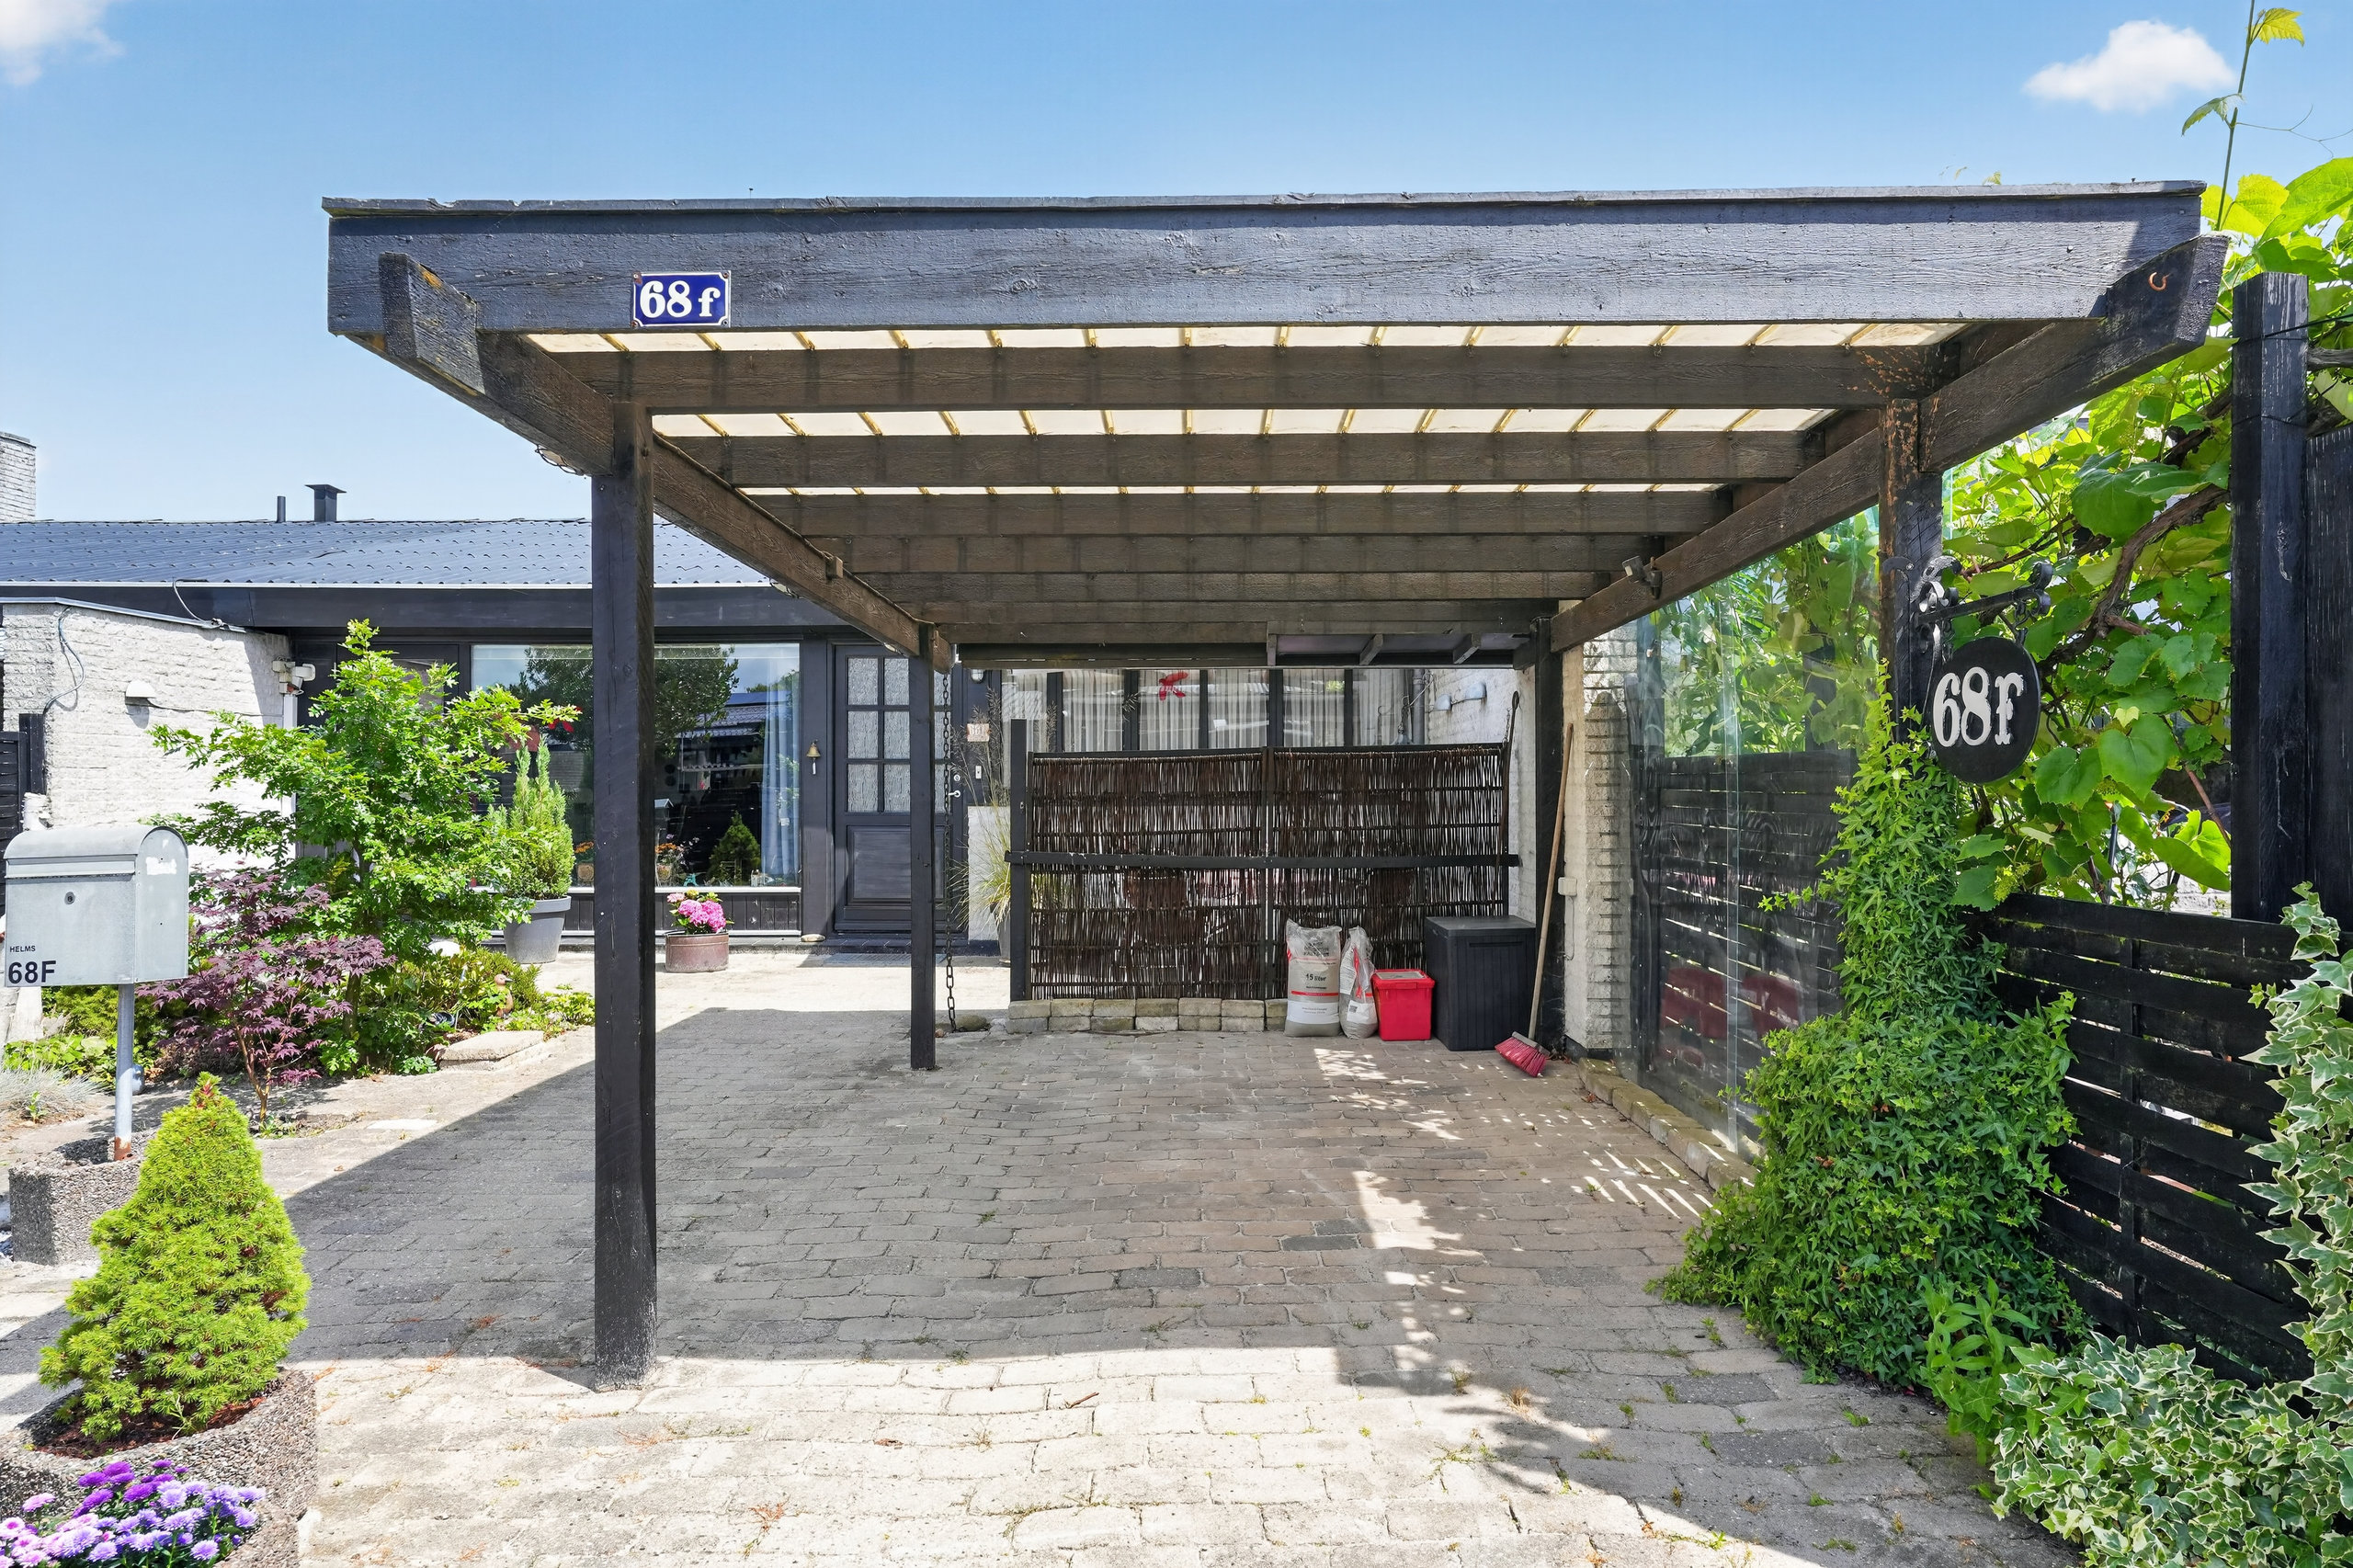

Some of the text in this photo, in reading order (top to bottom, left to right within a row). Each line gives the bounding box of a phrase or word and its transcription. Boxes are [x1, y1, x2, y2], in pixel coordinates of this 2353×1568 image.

[640, 280, 722, 318] 68 f
[8, 960, 56, 983] 68F
